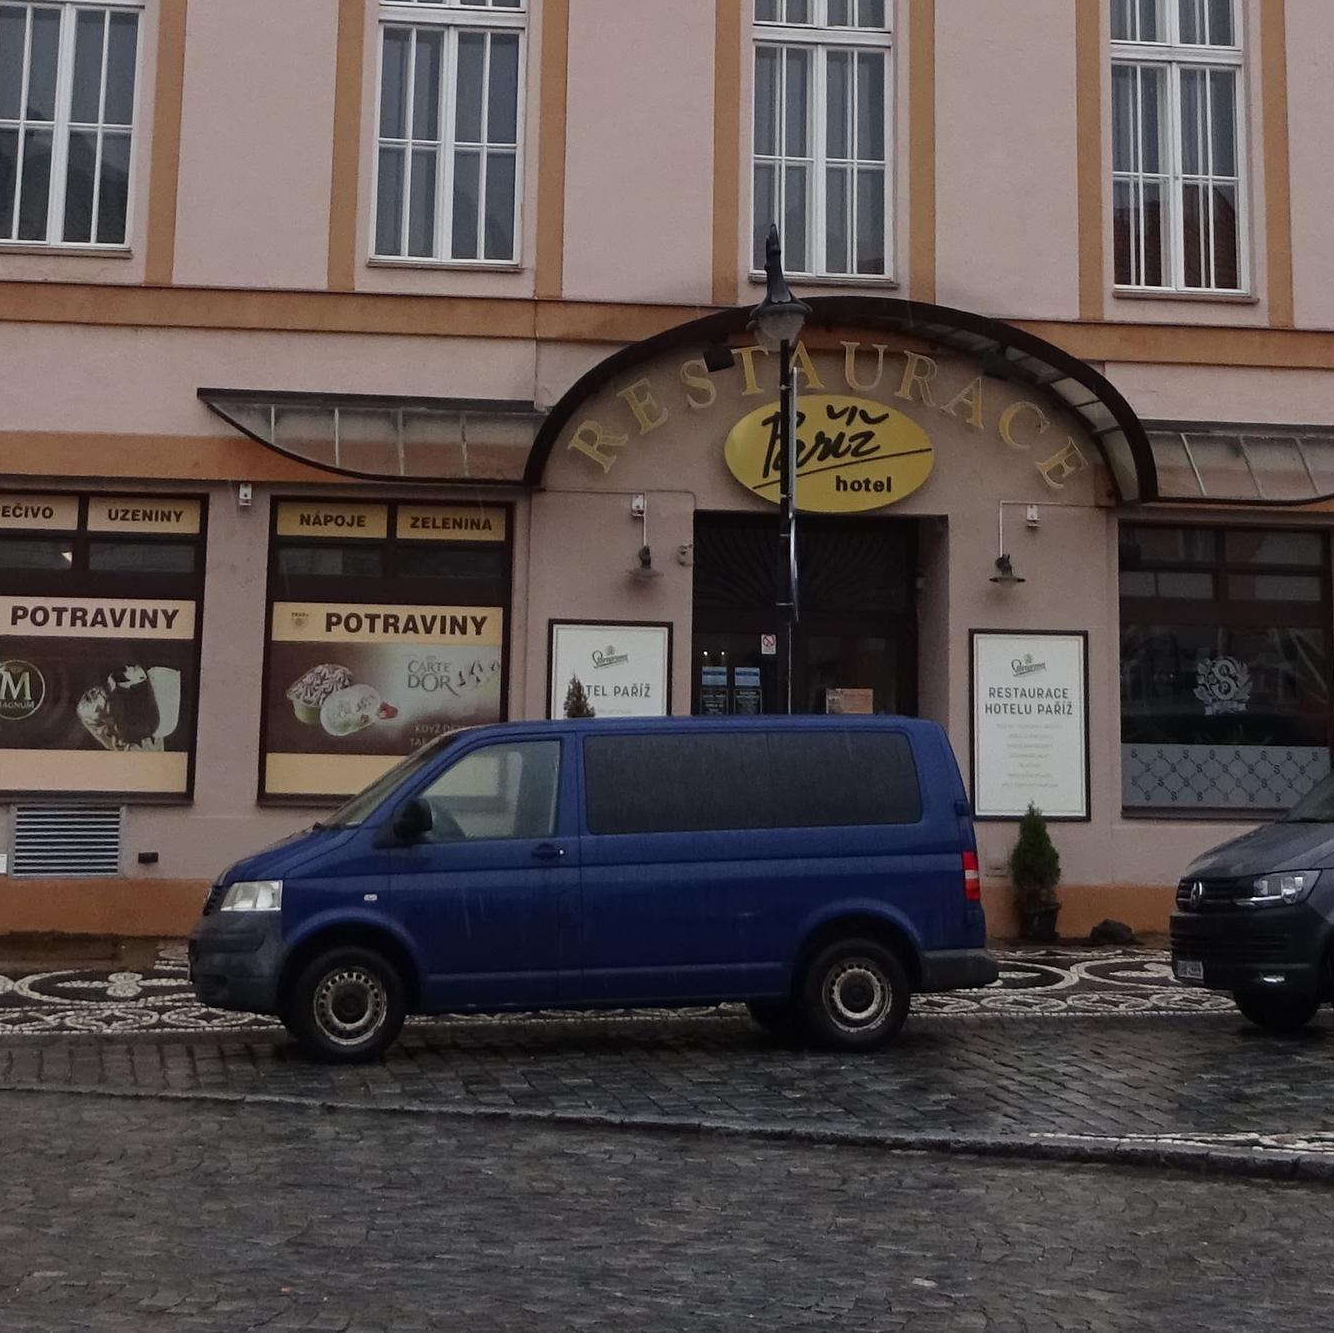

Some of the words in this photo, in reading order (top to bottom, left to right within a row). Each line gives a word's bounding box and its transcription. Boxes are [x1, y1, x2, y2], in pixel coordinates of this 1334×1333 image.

[569, 341, 1090, 489] RESTAURACE
[835, 475, 892, 493] hotel
[108, 508, 184, 523] UZENINY
[299, 511, 367, 528] NÁPOJE
[410, 516, 493, 531] ZELENINA
[10, 605, 180, 629] POTRAVINY
[325, 612, 488, 636] POTRAVINY
[407, 660, 452, 674] CARTE
[613, 682, 651, 698] PAŘÍŽ
[988, 687, 1069, 699] RESTAURACE
[985, 703, 1032, 715] HOTELU
[1037, 701, 1073, 716] PAŘÍŽ
